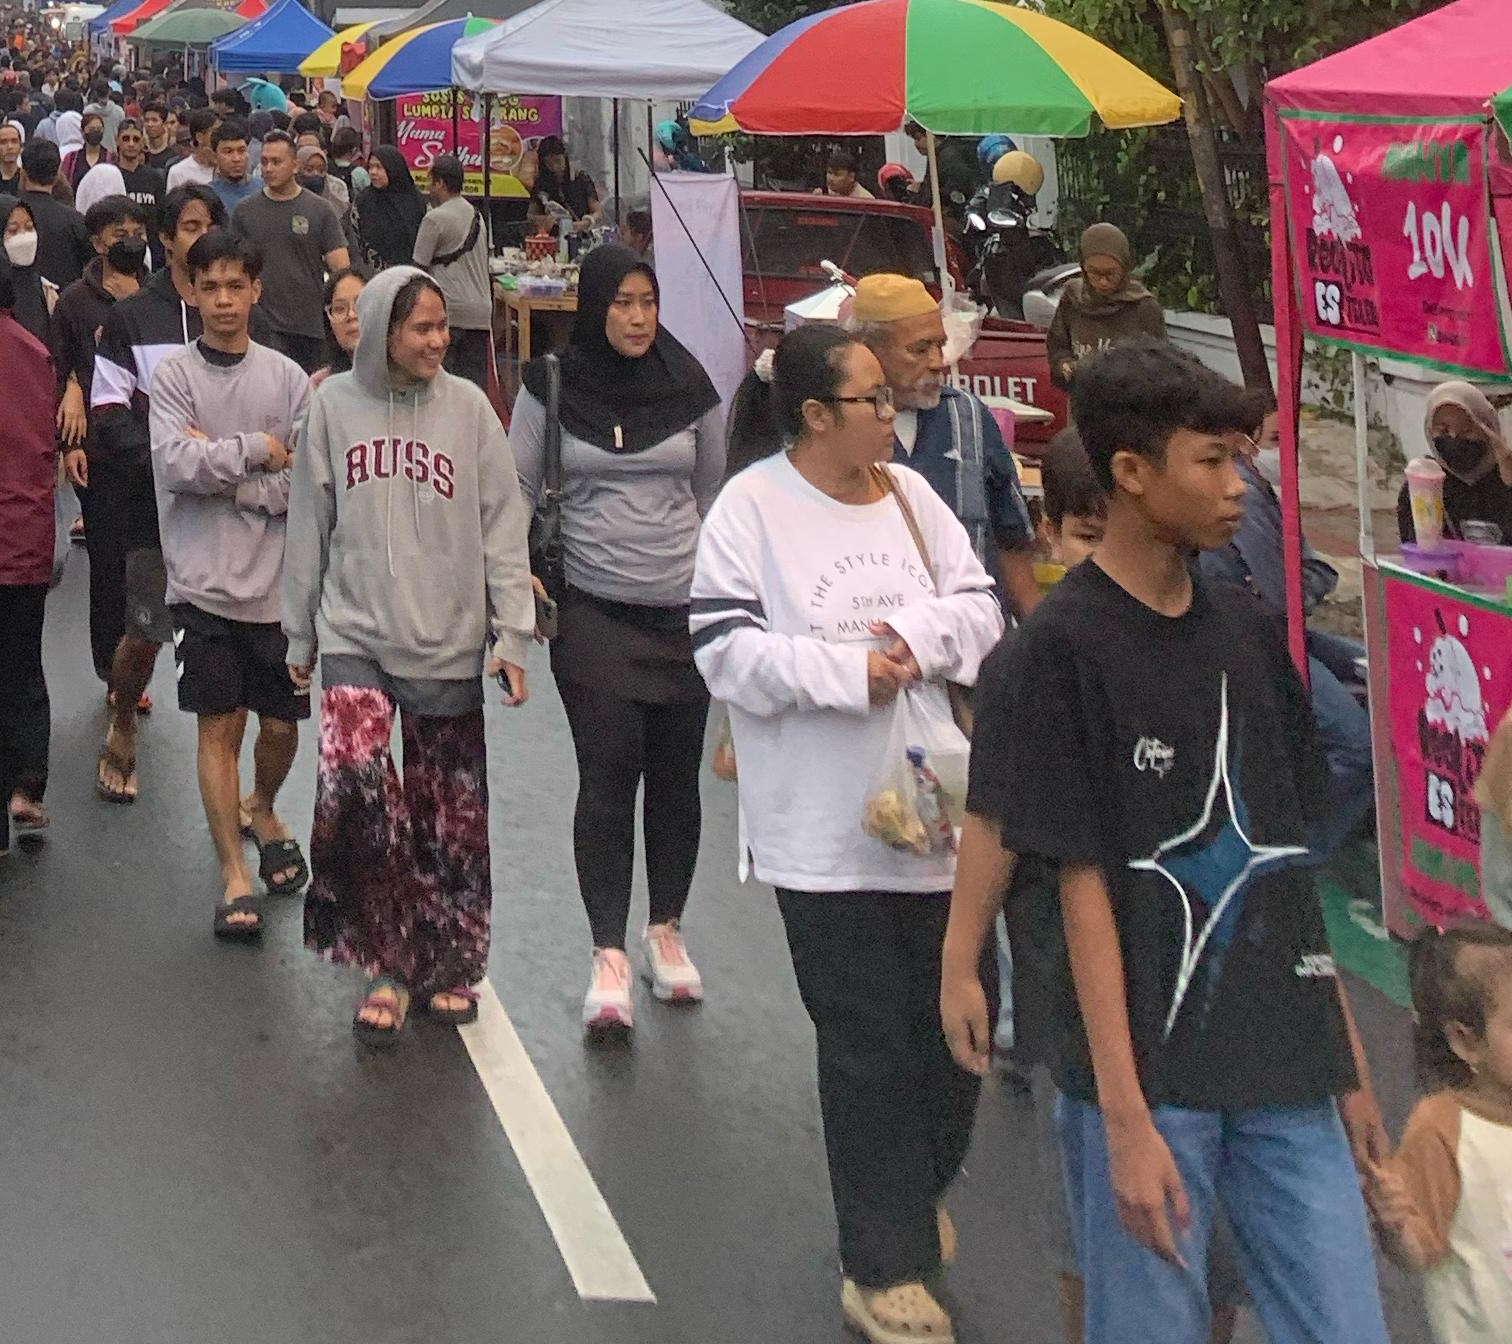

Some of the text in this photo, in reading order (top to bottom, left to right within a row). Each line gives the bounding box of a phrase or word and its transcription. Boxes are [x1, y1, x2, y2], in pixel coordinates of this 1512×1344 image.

[462, 107, 540, 122] SRANG
[1315, 280, 1341, 325] ES
[947, 373, 1038, 404] ROLET
[810, 573, 834, 609] THE
[833, 552, 890, 575] STYLE
[877, 593, 905, 609] AVE
